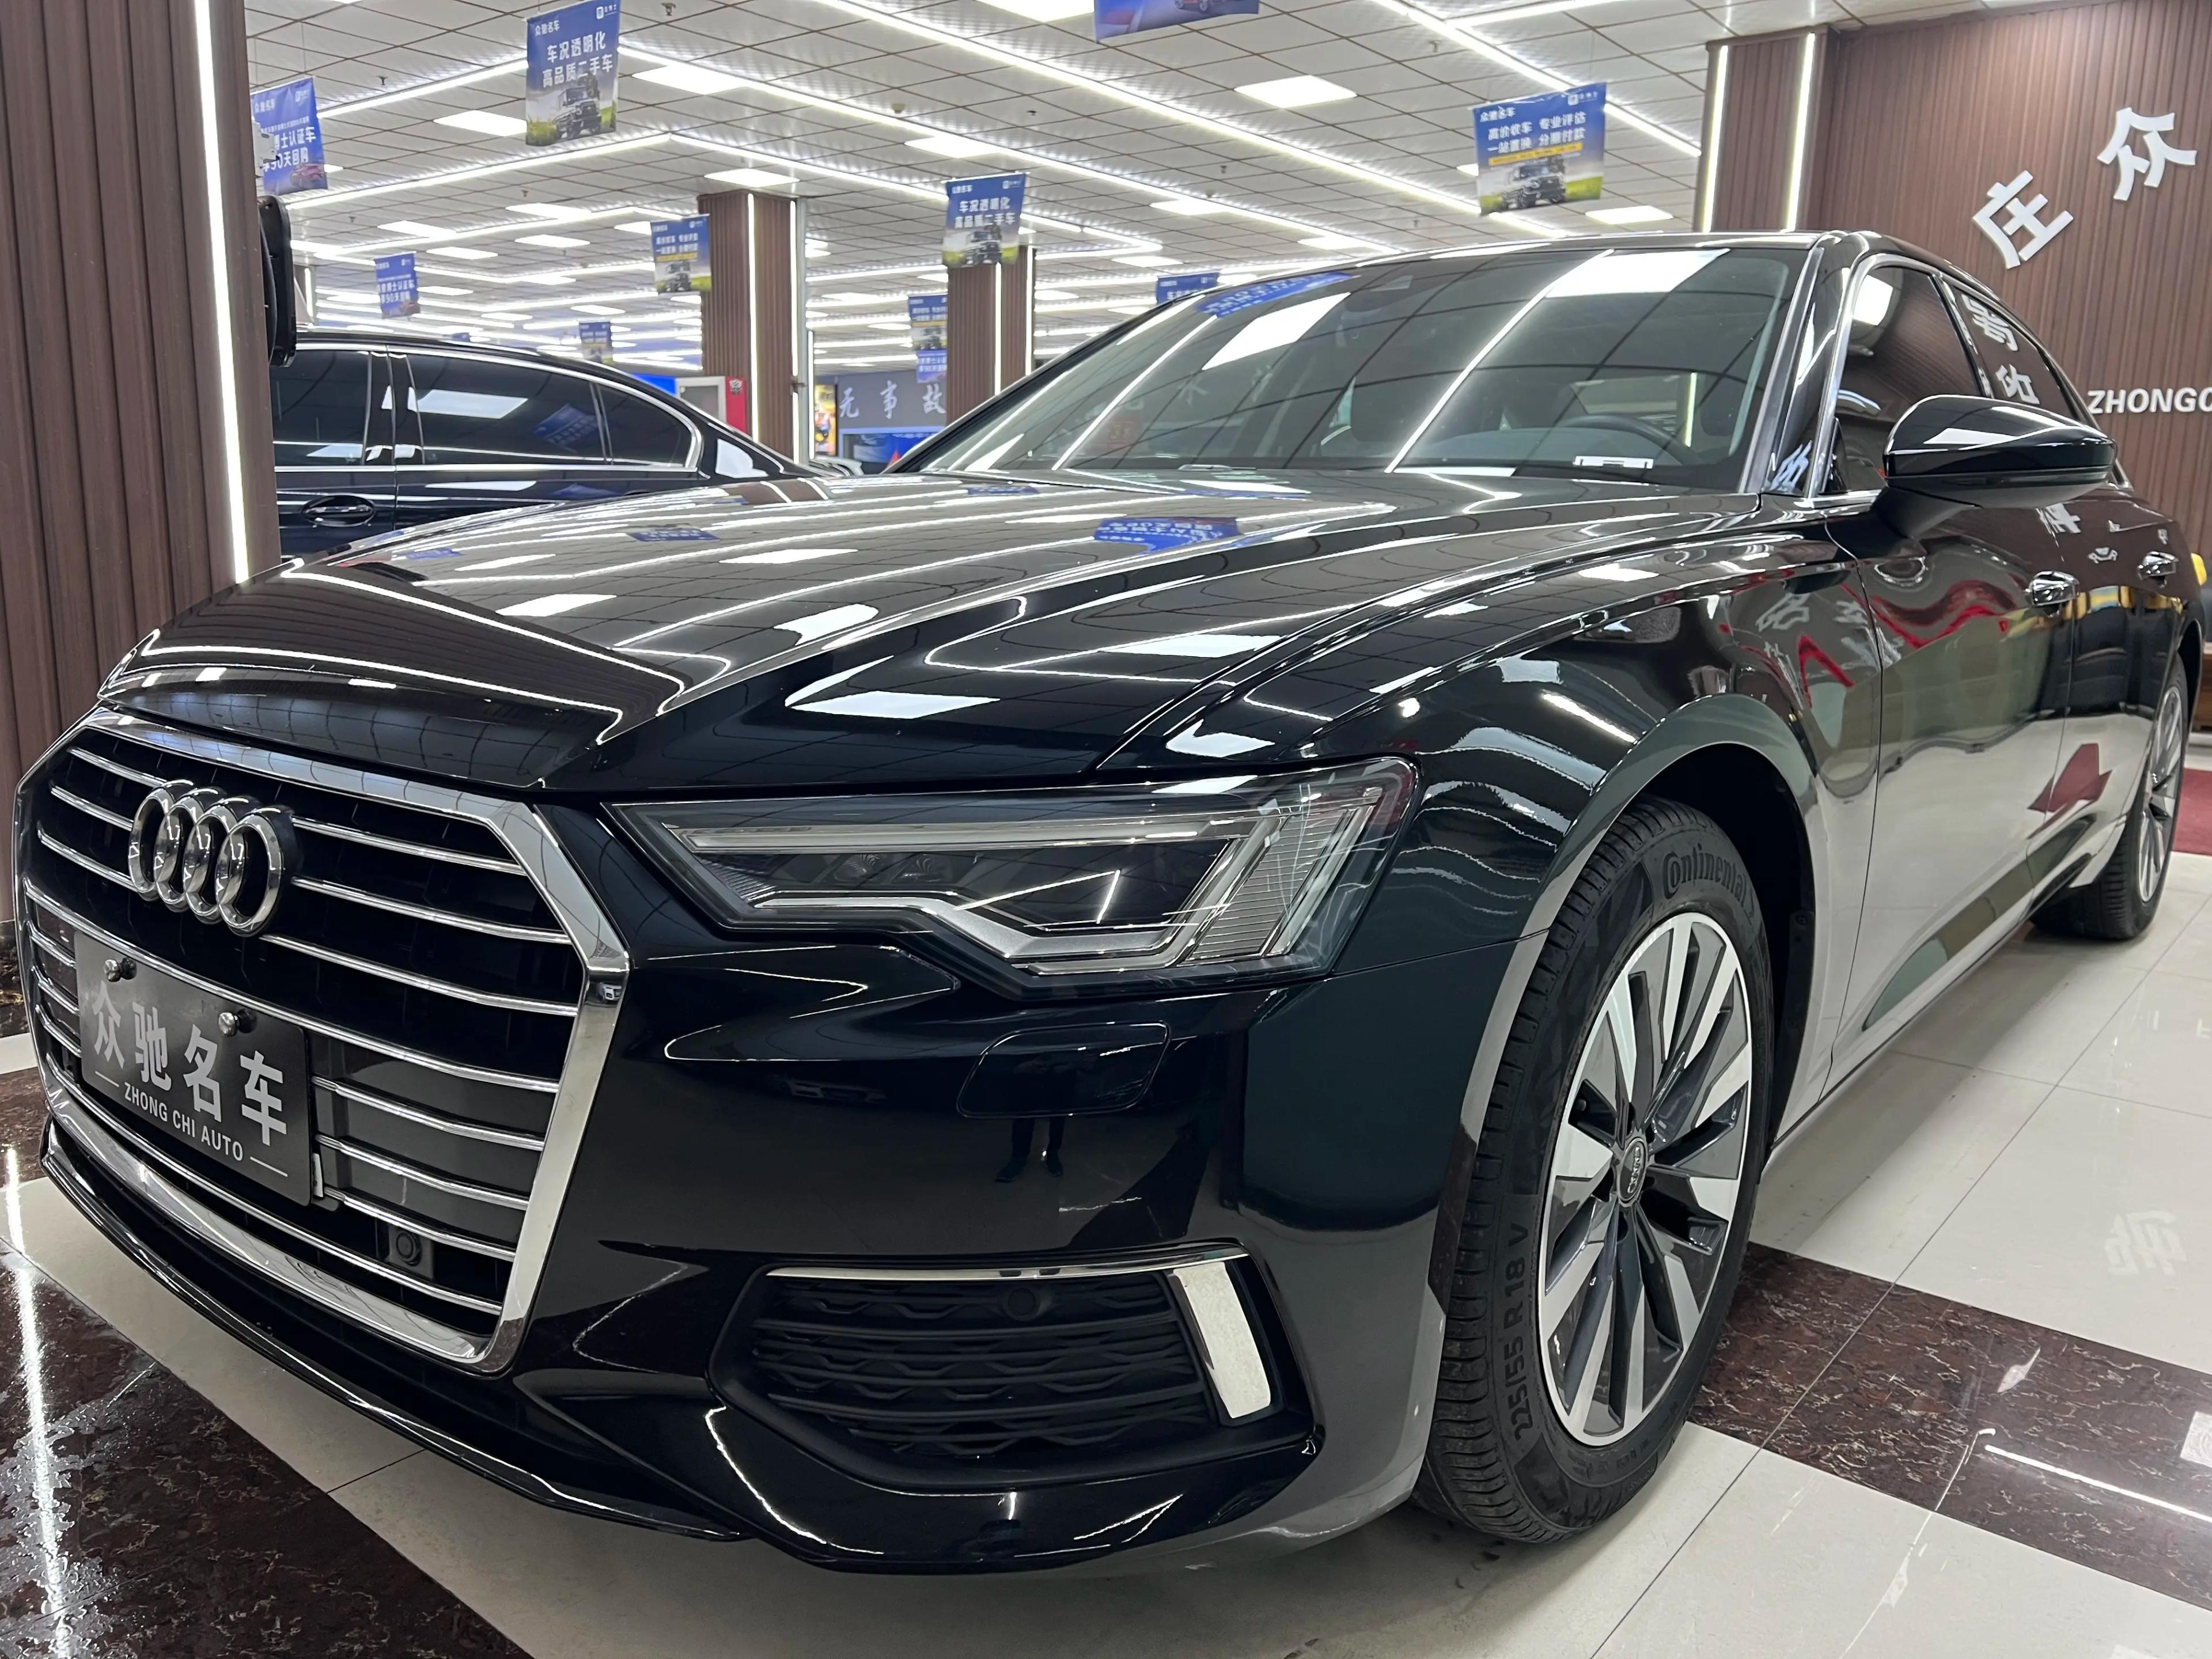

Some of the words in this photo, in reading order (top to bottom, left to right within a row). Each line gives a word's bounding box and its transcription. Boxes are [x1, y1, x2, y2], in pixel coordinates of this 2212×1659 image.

[542, 54, 613, 88] 高品质二手车
[547, 31, 605, 63] 车况透明化
[1662, 843, 1747, 907] Continental
[92, 980, 287, 1146] 众驰名车
[124, 1082, 168, 1122] ZHONG
[173, 1110, 195, 1138] CHI
[201, 1126, 243, 1161] AUTO
[1509, 1223, 1528, 1247] V
